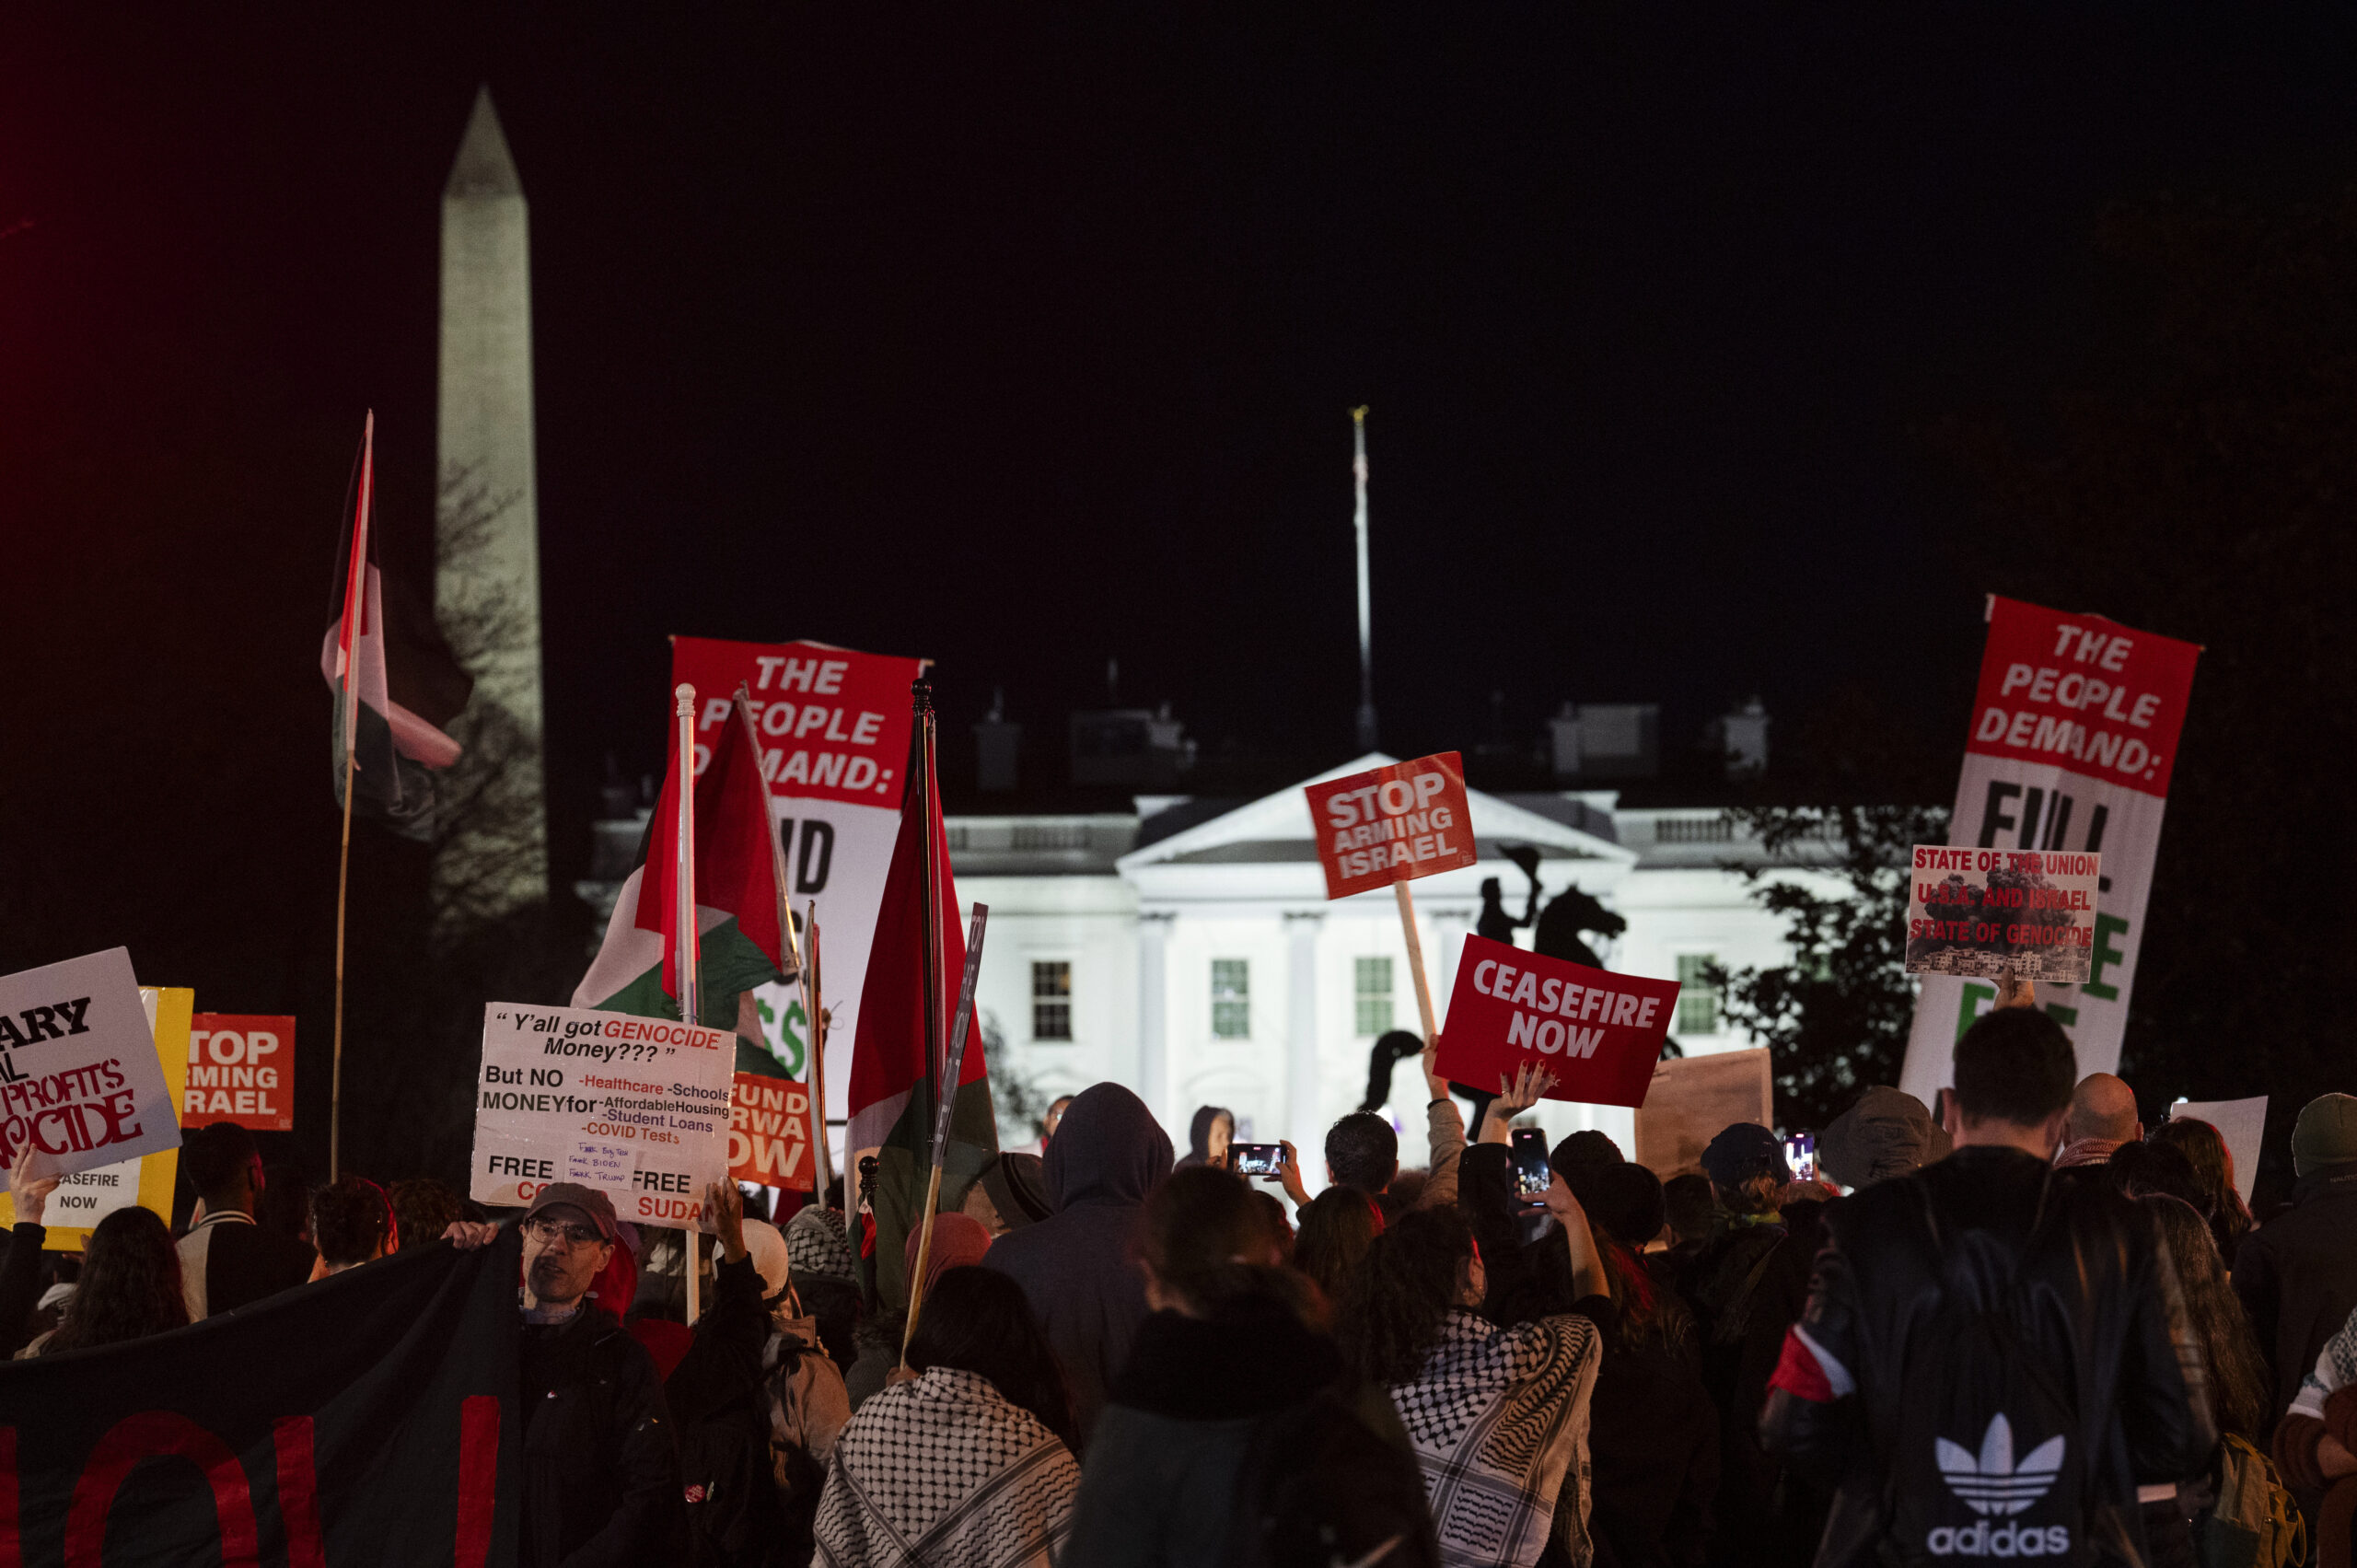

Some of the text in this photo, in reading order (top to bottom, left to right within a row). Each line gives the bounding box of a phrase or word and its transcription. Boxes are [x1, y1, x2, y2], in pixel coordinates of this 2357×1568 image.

[2054, 624, 2134, 672] THE
[756, 656, 849, 695] THE
[2000, 662, 2162, 729] PEOPLE
[1975, 706, 2163, 781] DEMAND:
[692, 742, 894, 795] DMAND:
[1326, 772, 1446, 829] STOP
[1334, 806, 1454, 854] ARMING
[1338, 832, 1458, 879] ISRAEL
[1914, 848, 2099, 876] STATE OF THE UNION
[1918, 883, 2092, 911] U.S.A. AND ISRAEL
[1910, 919, 2094, 947] STATE OF GENOCIDE
[1473, 959, 1661, 1028] CEASEFIRE
[544, 1037, 658, 1063] Money???
[564, 1020, 601, 1040] got
[604, 1020, 722, 1050] GENOCIDE
[1506, 1010, 1606, 1059] NOW
[485, 1065, 563, 1088] But NO
[578, 1074, 664, 1095] -Healthcare
[581, 1122, 680, 1144] -COVID Tests
[602, 1109, 714, 1133] -Student Loans
[489, 1156, 553, 1179] FREE
[60, 1196, 98, 1209] NOW
[1927, 1520, 2070, 1558] adidas
